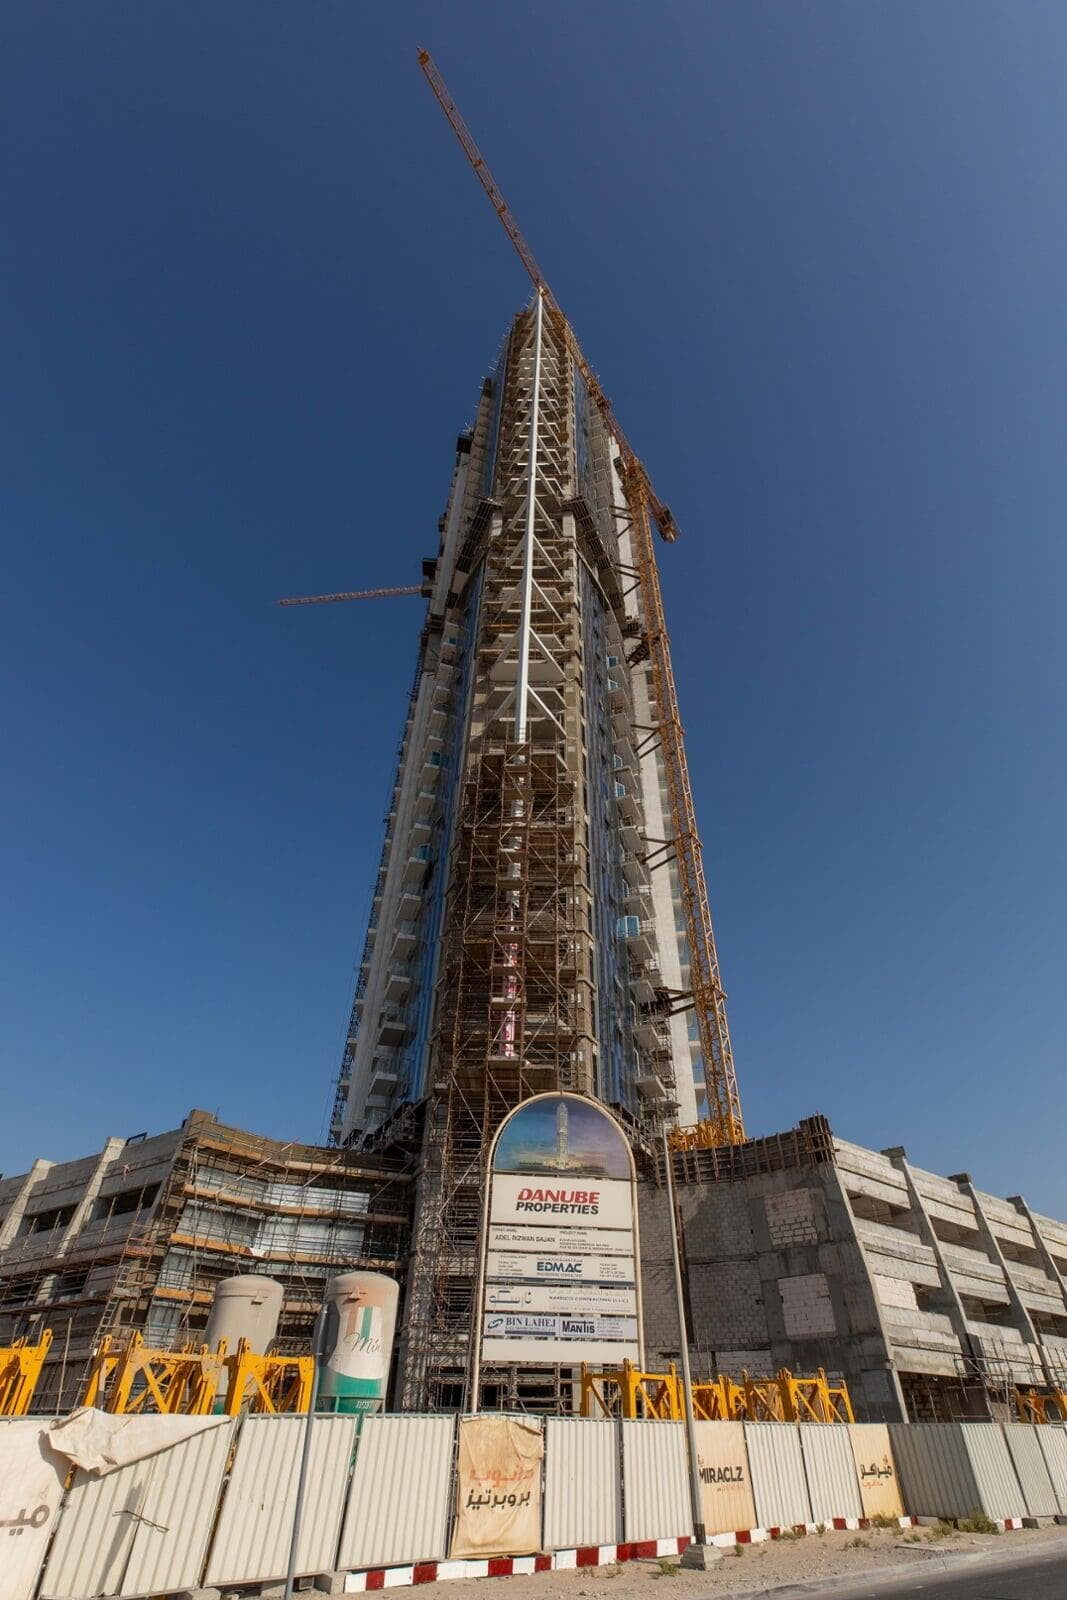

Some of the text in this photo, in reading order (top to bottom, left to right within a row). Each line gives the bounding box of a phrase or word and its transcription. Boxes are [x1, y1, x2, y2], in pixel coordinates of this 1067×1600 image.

[517, 1188, 600, 1204] DANUBE
[515, 1201, 599, 1215] PROPERTIES
[536, 1261, 582, 1273] EDMAC
[506, 1317, 556, 1328] BIN LAHEJ
[699, 1466, 744, 1484] MIRACLZ
[465, 1489, 531, 1511] بروبرتيز
